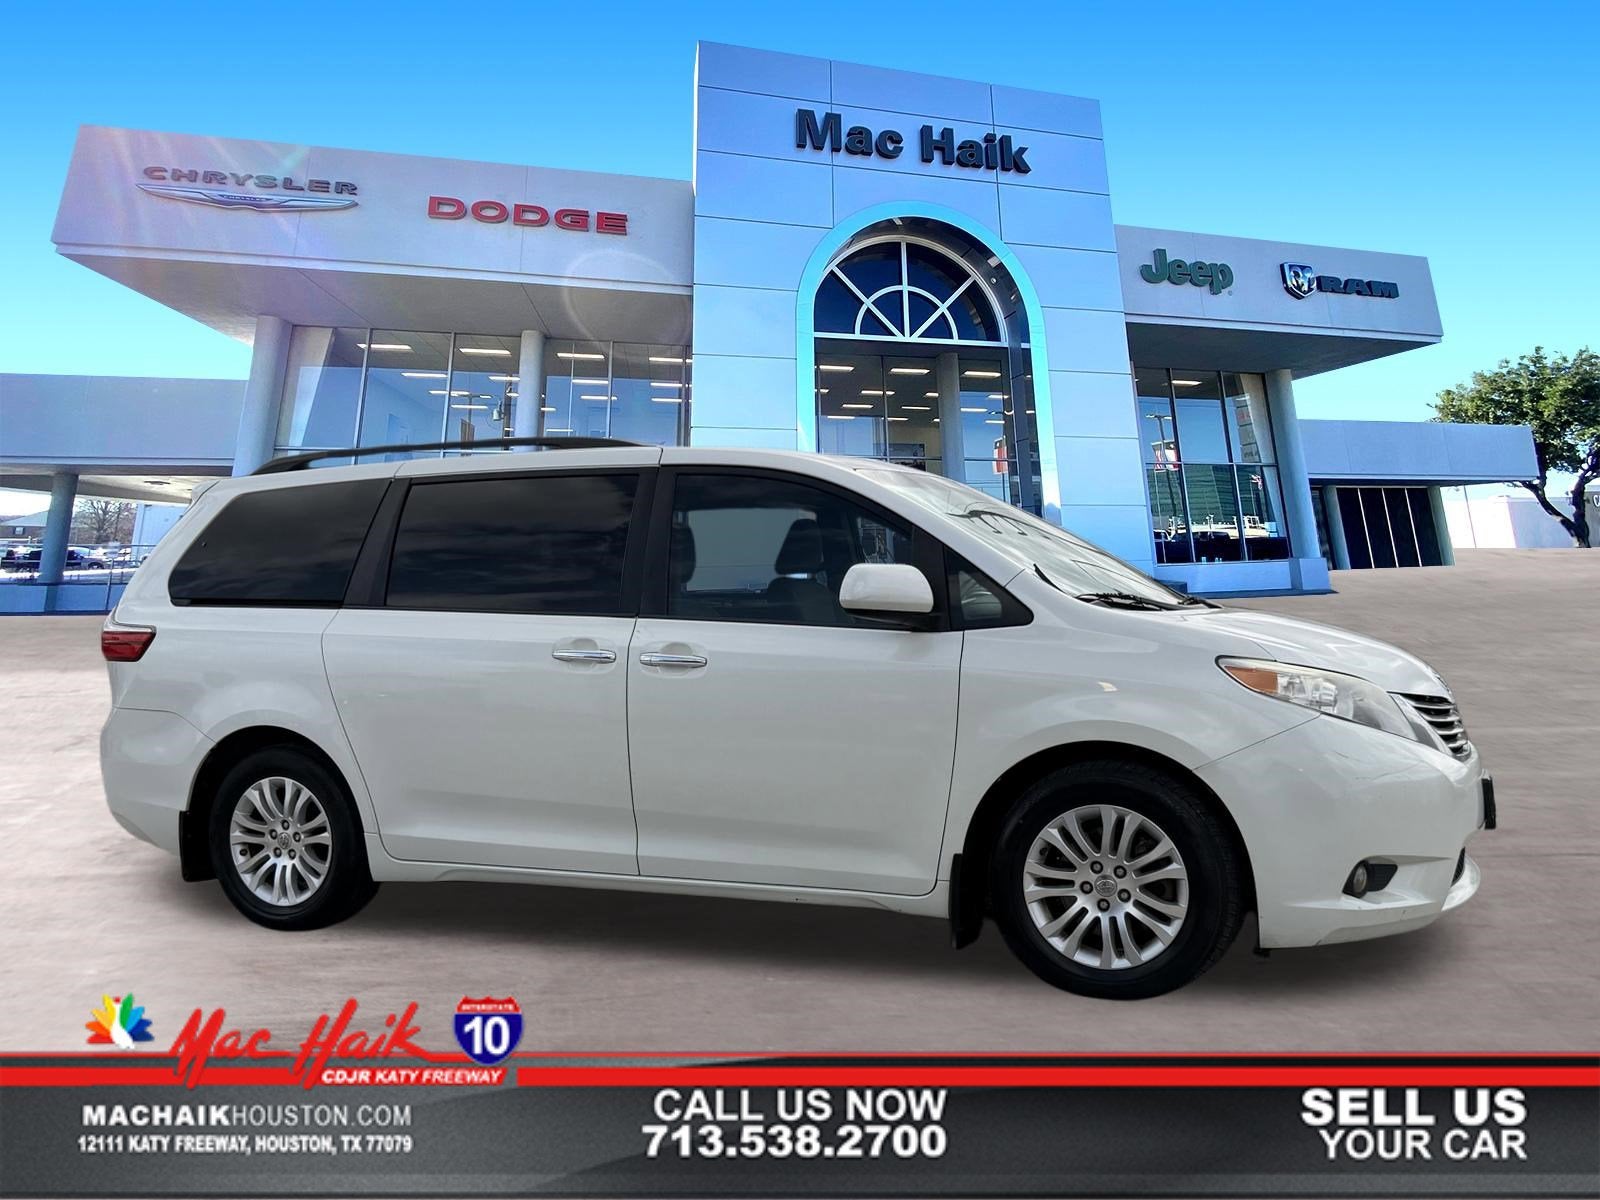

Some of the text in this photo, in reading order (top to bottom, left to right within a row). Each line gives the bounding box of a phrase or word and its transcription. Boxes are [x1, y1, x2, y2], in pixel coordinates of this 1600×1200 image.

[796, 108, 1032, 174] Mac Haik
[143, 166, 358, 196] CHRYSLER
[428, 196, 628, 236] DODGE
[1140, 248, 1234, 295] Jeep
[1316, 275, 1399, 299] RAM
